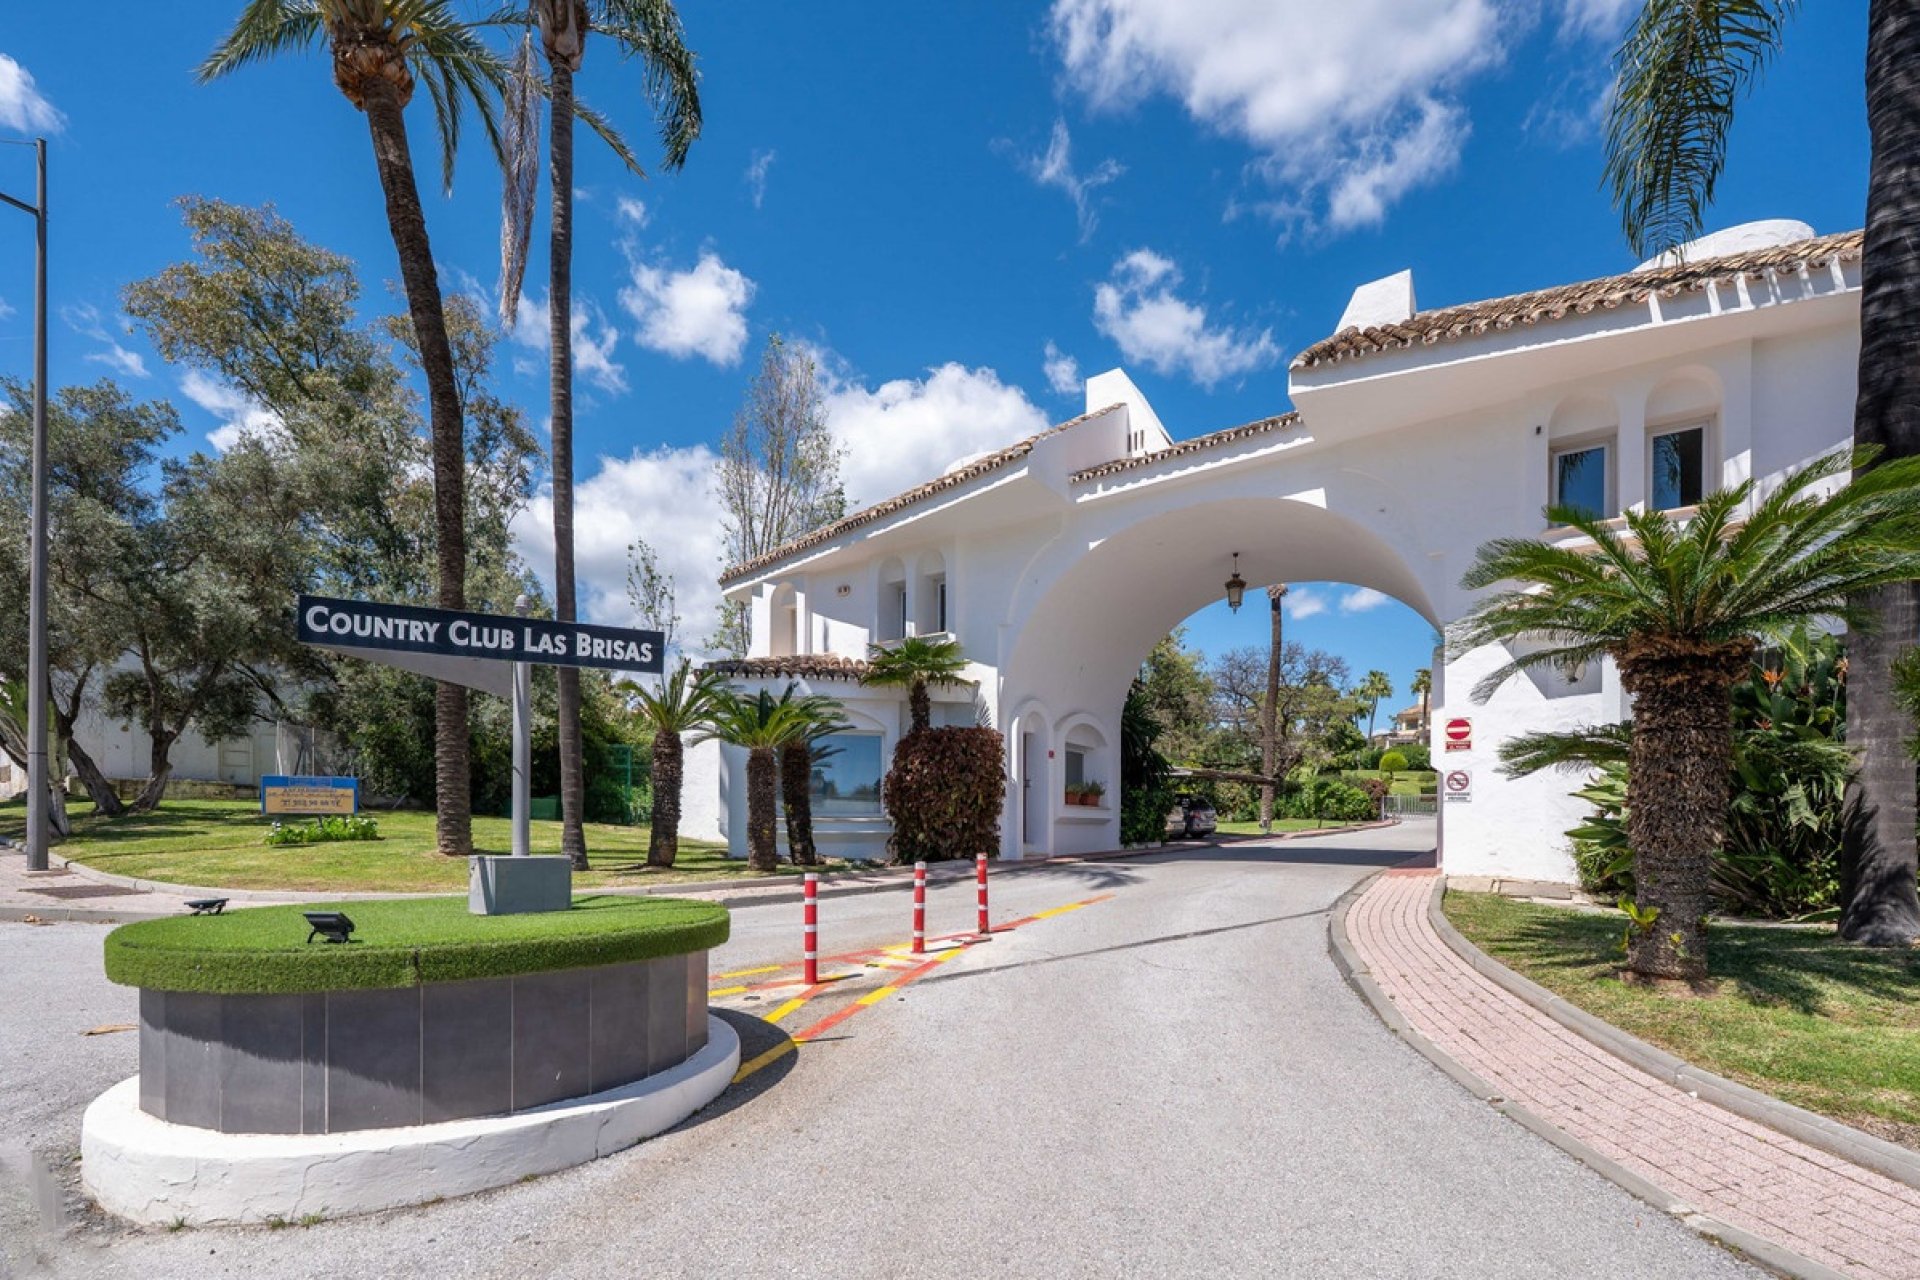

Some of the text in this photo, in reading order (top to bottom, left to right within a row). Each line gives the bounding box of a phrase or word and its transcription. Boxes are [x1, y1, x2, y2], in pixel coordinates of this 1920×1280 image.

[305, 605, 653, 663] COUNTRY CLUB LAS BRISAS
